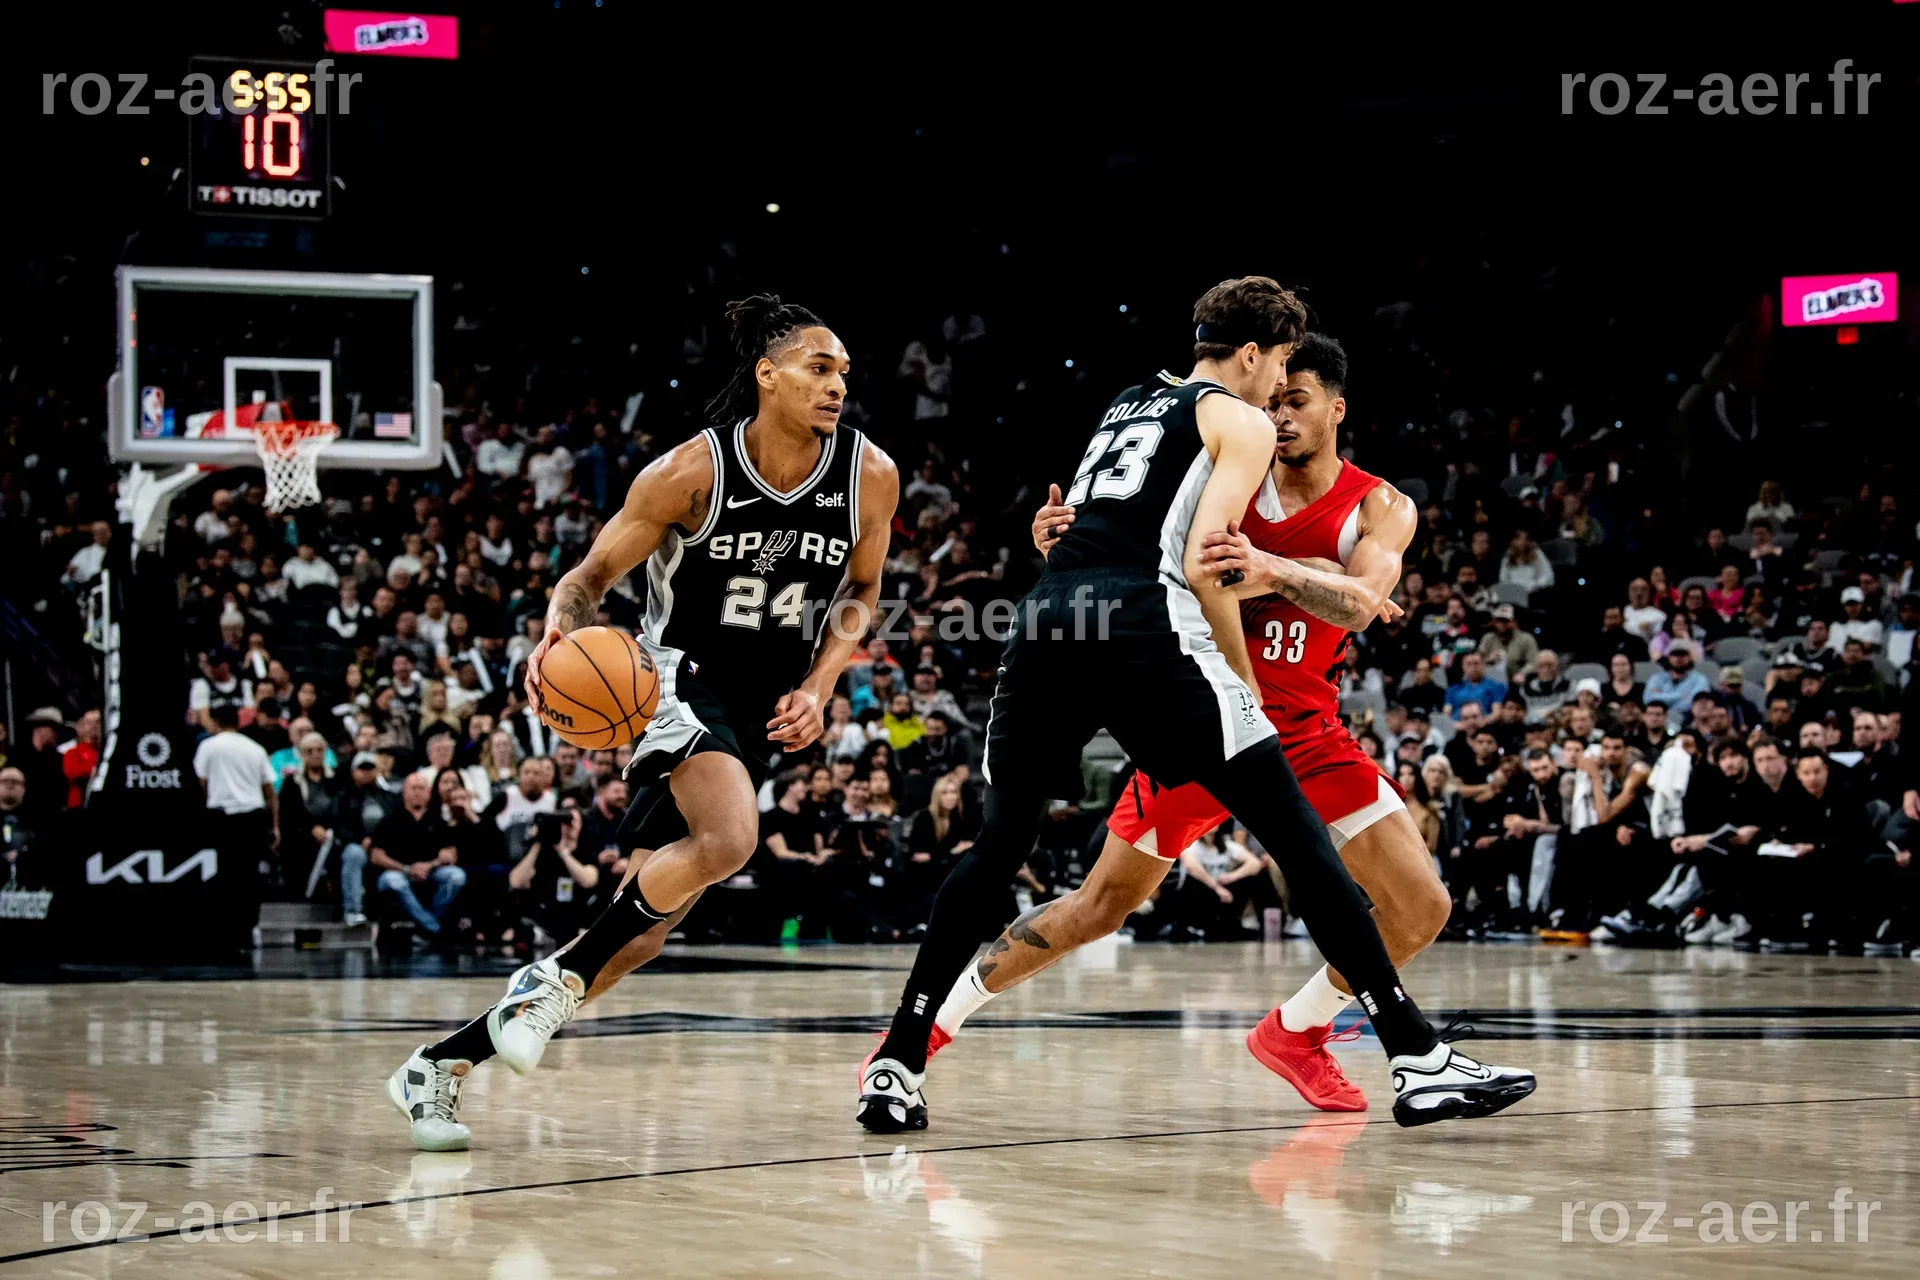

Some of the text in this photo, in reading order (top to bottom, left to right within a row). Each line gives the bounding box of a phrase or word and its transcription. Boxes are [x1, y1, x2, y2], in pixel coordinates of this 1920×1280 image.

[230, 69, 311, 112] 5:55
[244, 112, 301, 177] 10
[231, 186, 322, 208] TISSOT
[1100, 397, 1179, 429] COLLINS
[1064, 420, 1165, 506] 23
[815, 492, 845, 507] Self.
[709, 530, 849, 574] SPURS
[719, 575, 809, 631] 24
[1262, 619, 1308, 664] 33
[126, 764, 182, 788] Frost
